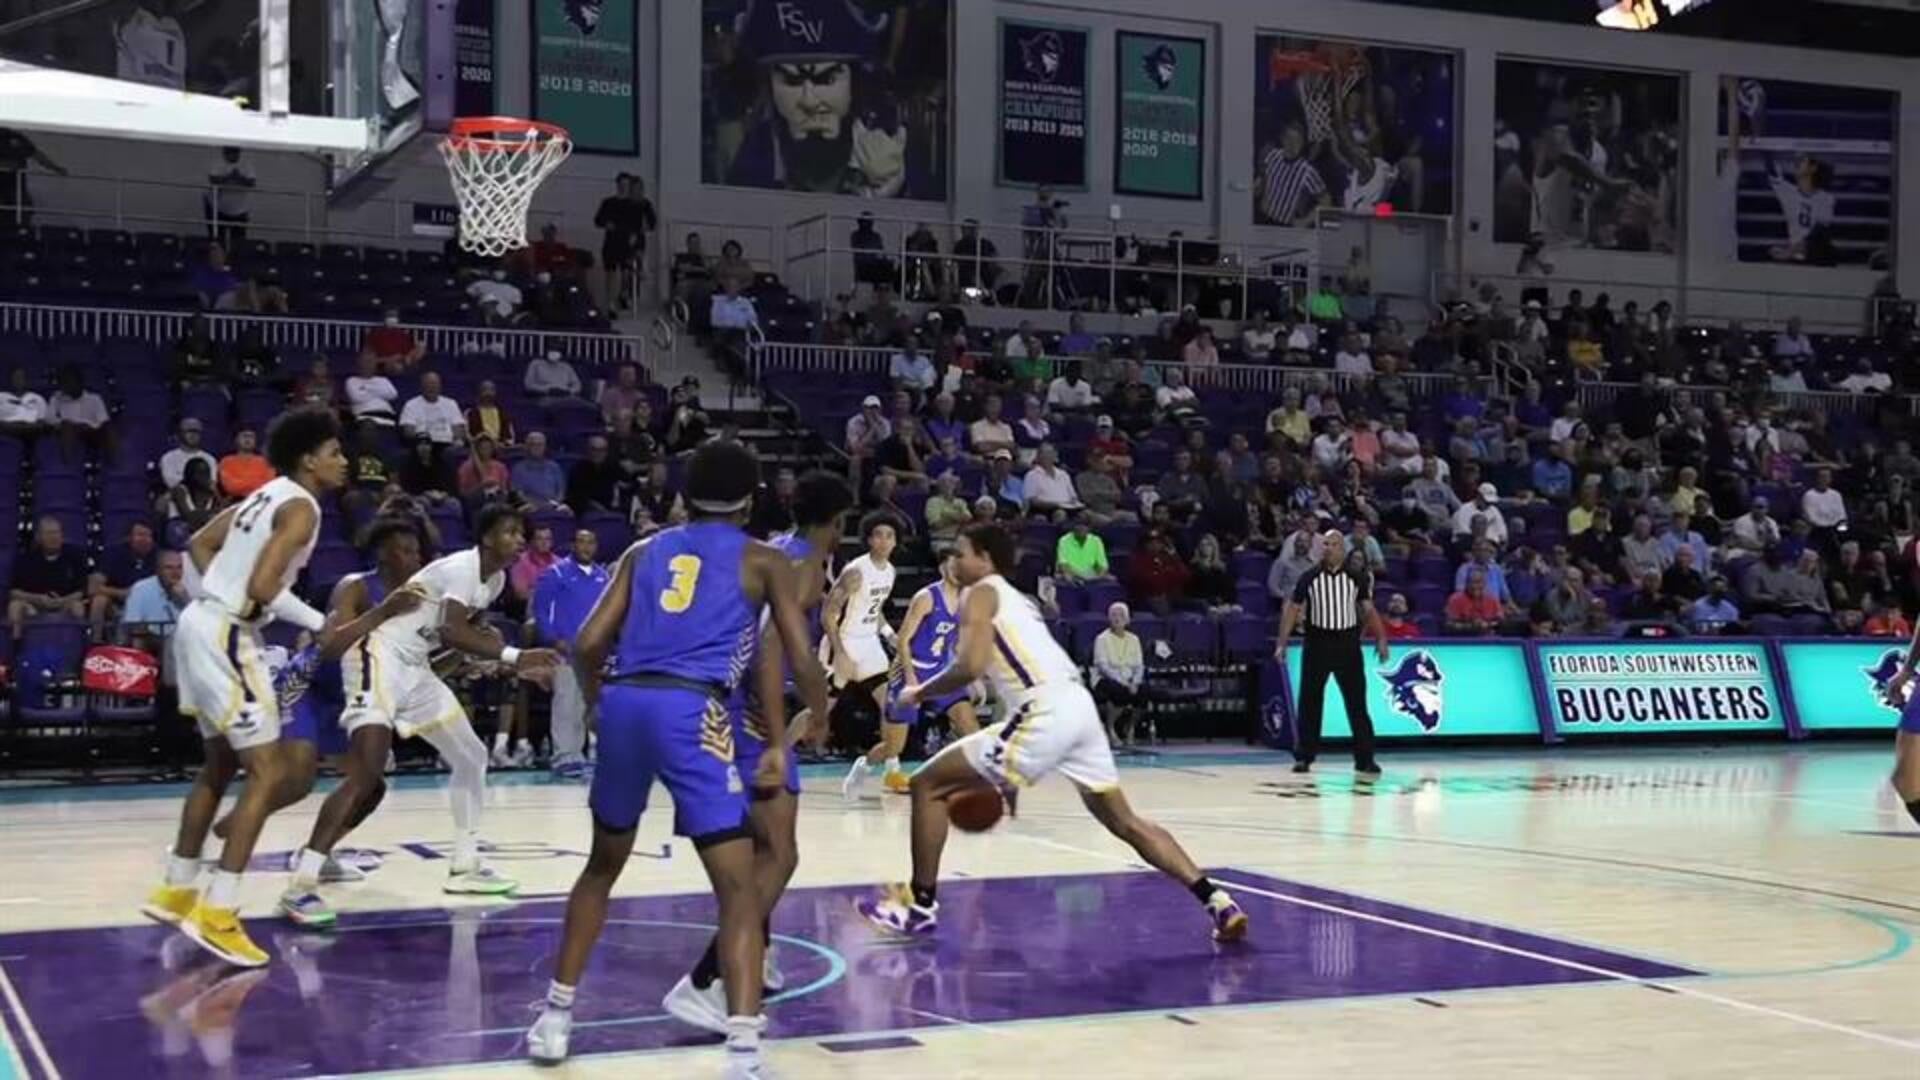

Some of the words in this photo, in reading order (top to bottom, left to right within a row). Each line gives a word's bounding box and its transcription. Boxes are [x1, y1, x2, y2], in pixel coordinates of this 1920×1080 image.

[776, 2, 824, 43] FSW
[660, 554, 701, 613] 3
[931, 636, 946, 657] 4
[1550, 655, 1620, 673] FLORIDA
[1625, 653, 1760, 672] SOUTHWESTERN
[1556, 686, 1771, 723] BUCCANEERS
